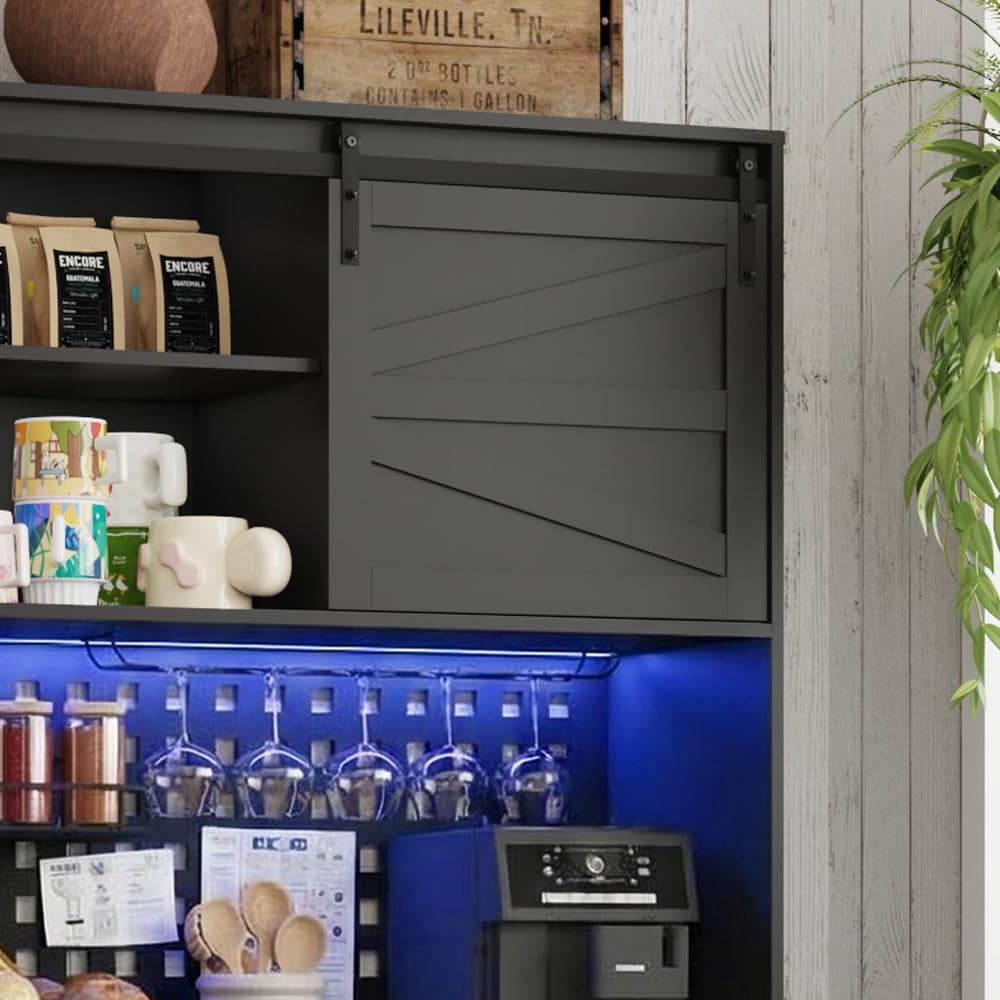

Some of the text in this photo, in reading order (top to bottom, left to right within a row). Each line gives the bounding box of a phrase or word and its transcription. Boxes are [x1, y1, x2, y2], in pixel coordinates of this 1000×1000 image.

[387, 60, 397, 80] 2
[439, 63, 517, 87] BOTTLES
[366, 86, 449, 108] CONTAINS
[474, 91, 537, 113] GALLON
[58, 255, 105, 269] ENCORE
[165, 260, 211, 274] ENCORE
[66, 274, 100, 282] GUATEMALA
[172, 279, 206, 288] GUATEMALA
